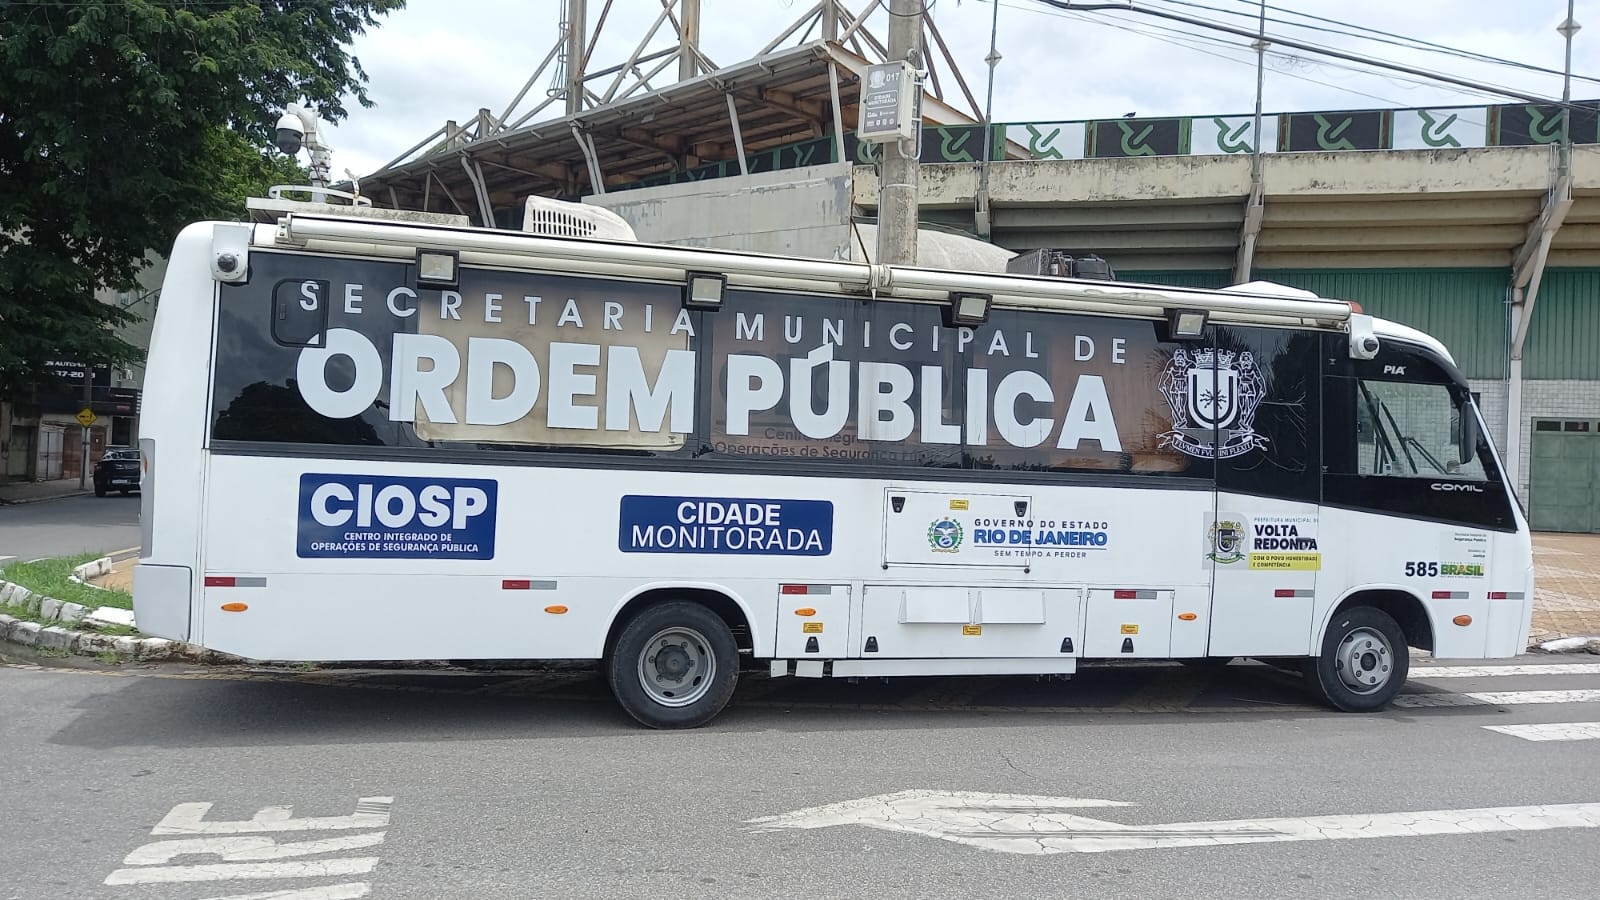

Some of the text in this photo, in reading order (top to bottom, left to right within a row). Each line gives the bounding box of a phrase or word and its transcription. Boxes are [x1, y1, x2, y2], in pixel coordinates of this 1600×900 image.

[886, 72, 900, 82] 017
[299, 280, 1126, 365] SECRETARIA MUNICIPAL DE
[296, 328, 1123, 453] ORDEM PÚBLICA
[1430, 483, 1483, 492] COMIL
[310, 482, 488, 530] CIOSP
[677, 501, 782, 526] CIDADE
[974, 518, 1109, 530] GOVERNO DO ESTADO
[344, 532, 452, 542] CENTRO INTEGRADO DE
[631, 525, 824, 550] MONITORADA
[974, 529, 1108, 546] RIO DE JANEIRO
[1254, 525, 1299, 537] VOLTA
[311, 541, 479, 554] OPERAÇÕES DE SEGURANÇA PÚBLICA
[1254, 538, 1318, 551] REDONDA
[1015, 550, 1043, 558] TEMPO
[1405, 561, 1484, 577] 585 BRASIL
